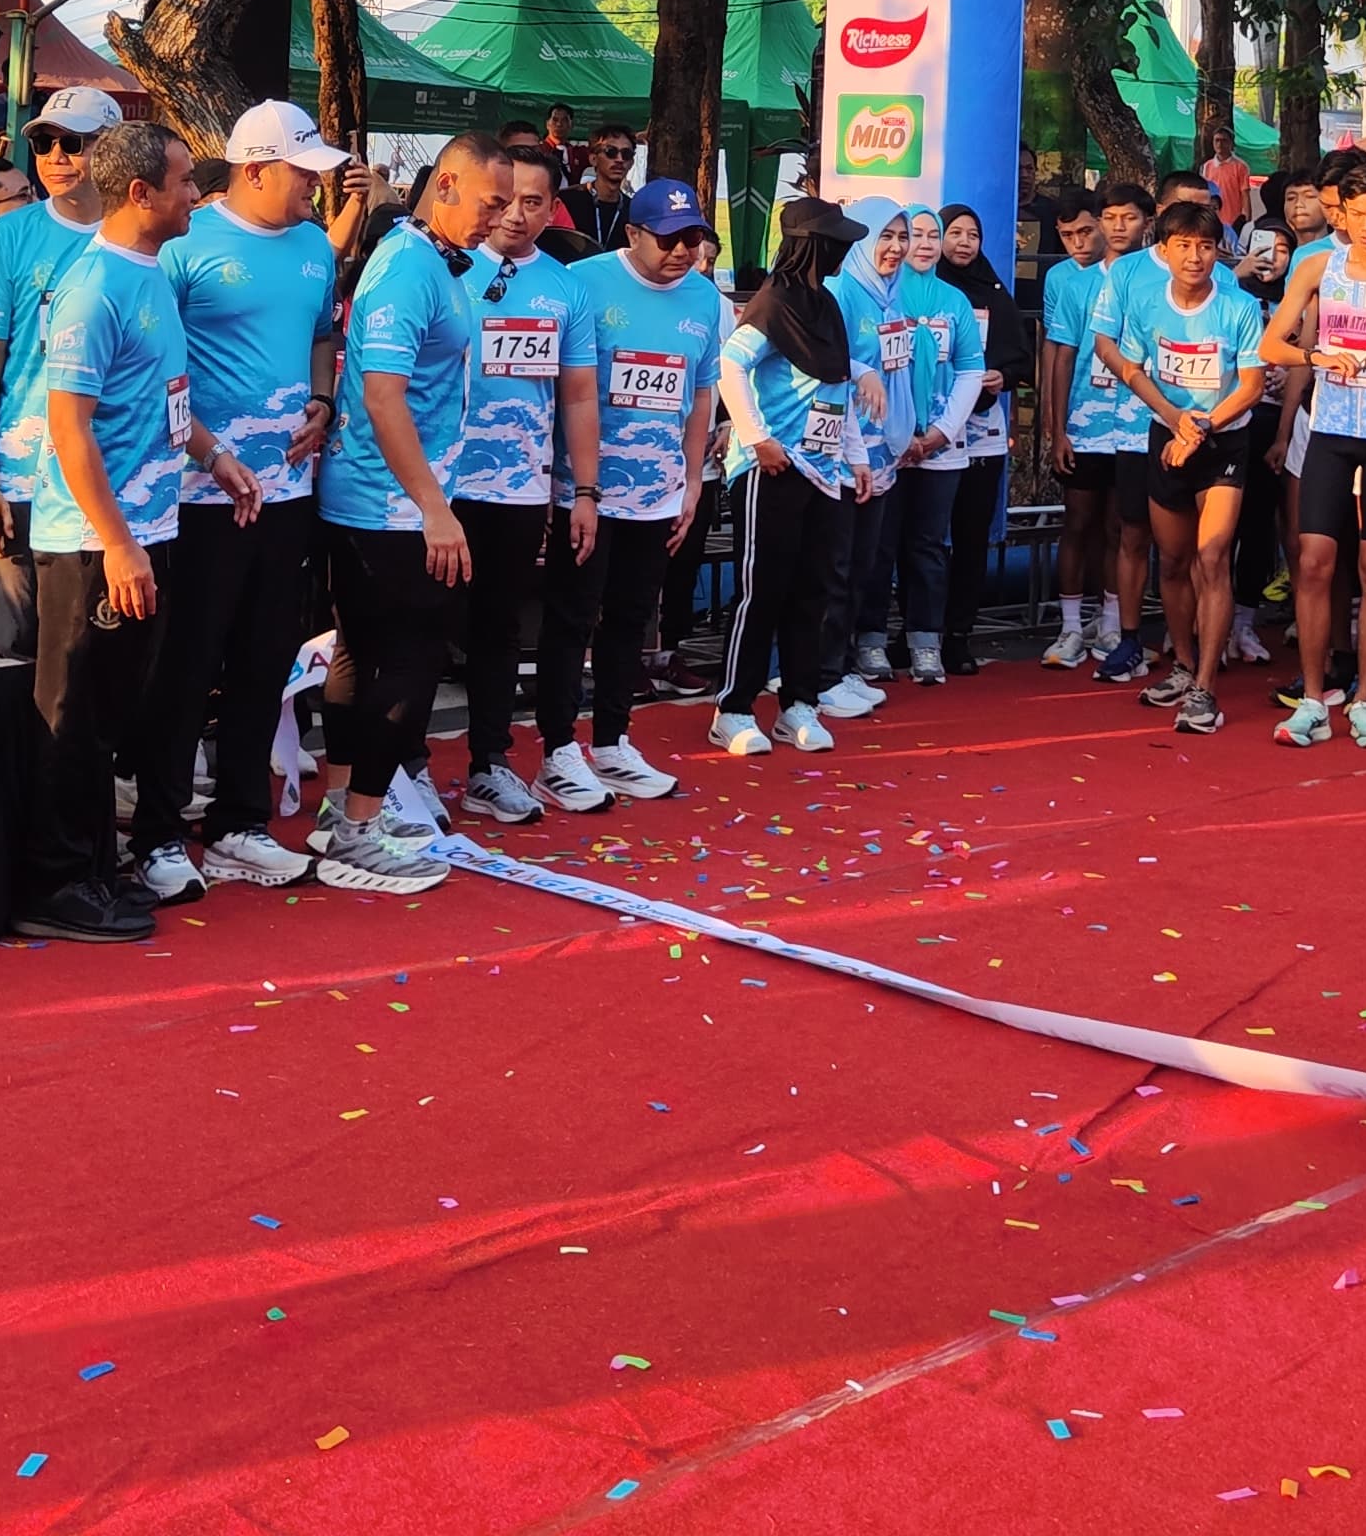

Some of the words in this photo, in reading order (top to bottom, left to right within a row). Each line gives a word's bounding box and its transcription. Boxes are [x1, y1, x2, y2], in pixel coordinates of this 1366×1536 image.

[846, 28, 912, 54] Richeese
[50, 93, 77, 111] H
[244, 145, 278, 157] TP5
[493, 336, 550, 358] 1754
[485, 365, 507, 375] 5KM
[1164, 354, 1212, 375] 1217
[621, 368, 678, 394] 1848
[612, 394, 633, 406] 5KM
